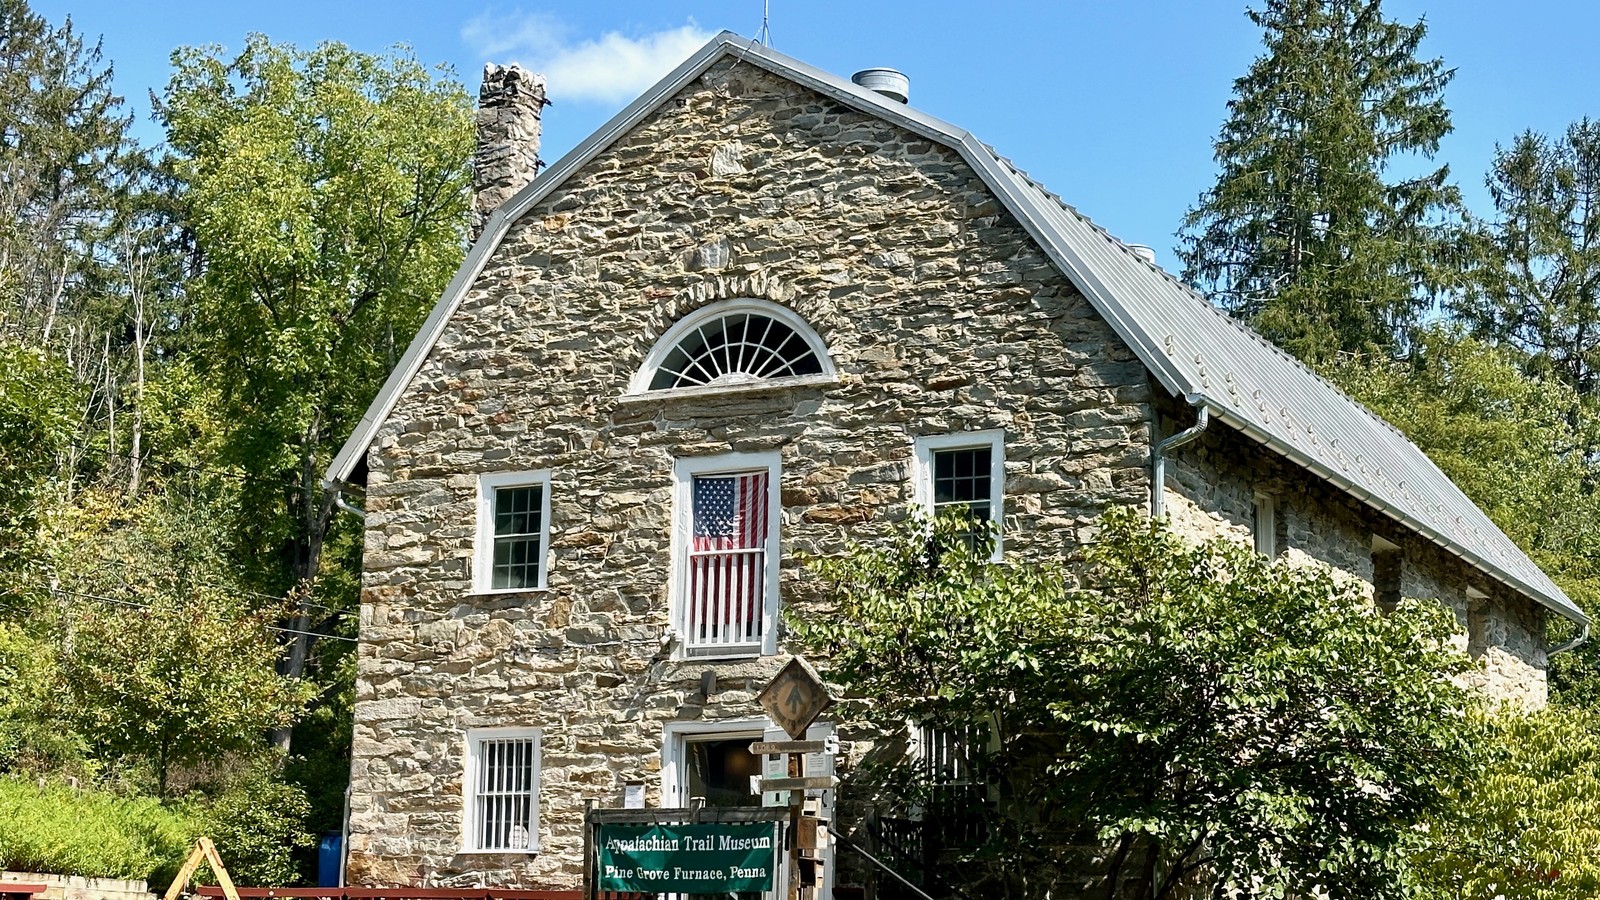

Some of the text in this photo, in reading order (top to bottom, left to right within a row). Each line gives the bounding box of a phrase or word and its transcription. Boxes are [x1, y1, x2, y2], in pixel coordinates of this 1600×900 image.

[605, 835, 771, 854] Appalachian Trail Museum
[605, 865, 767, 881] Pine Grove Furnace, Penna
